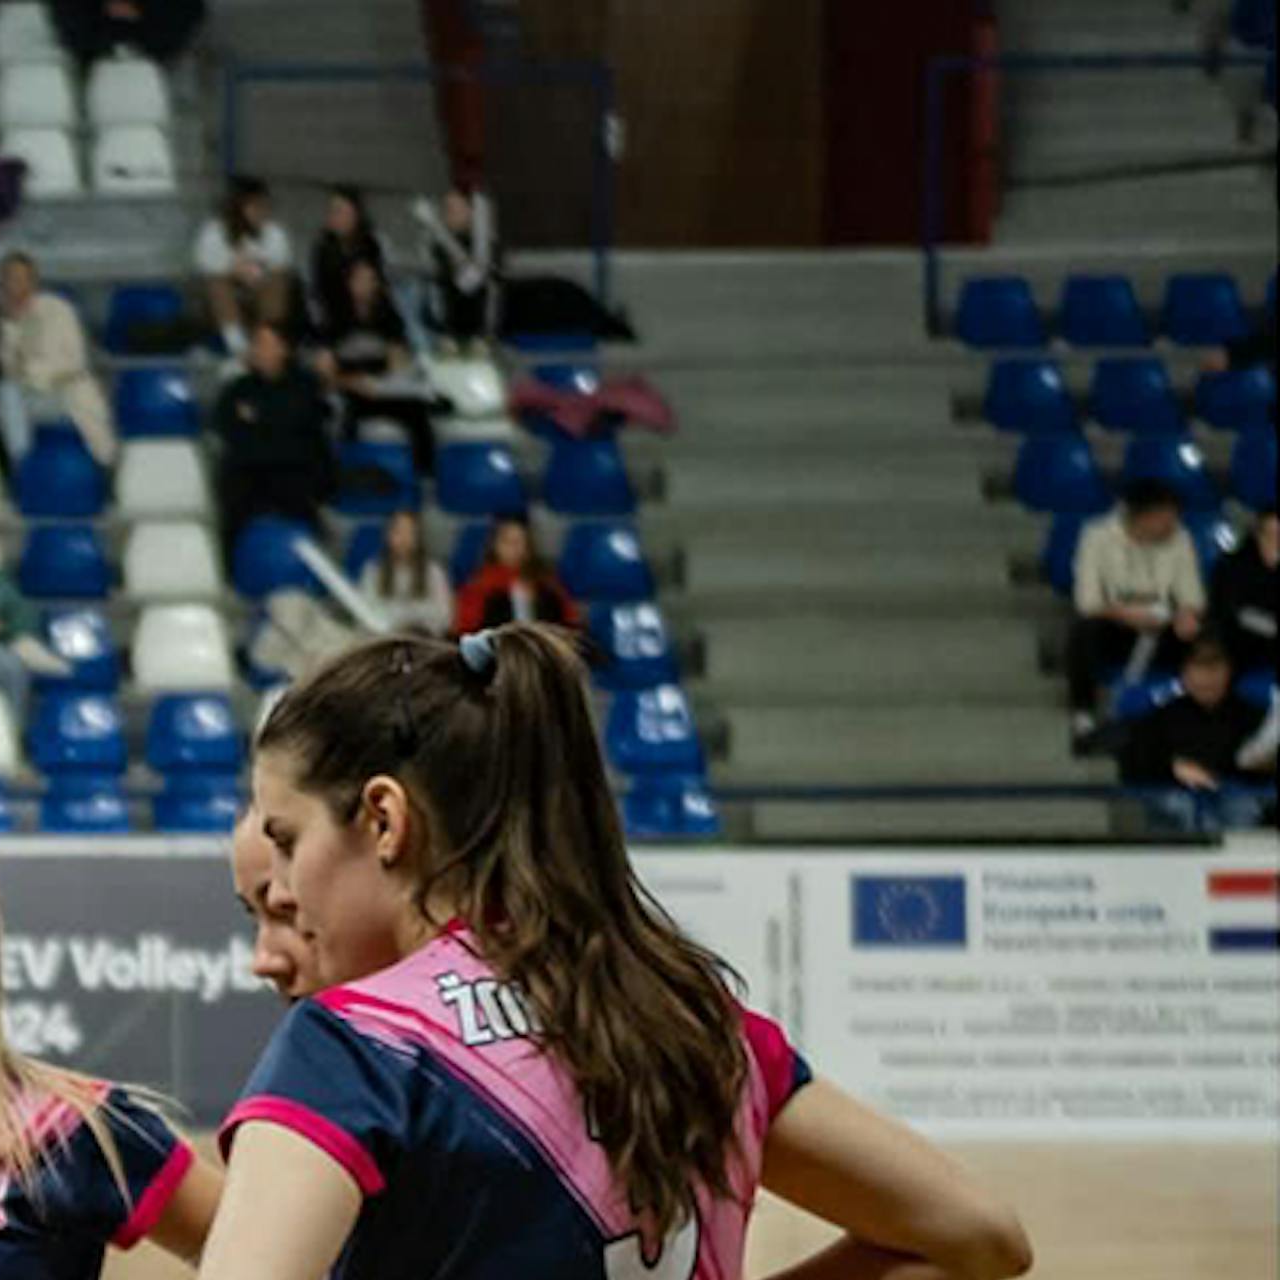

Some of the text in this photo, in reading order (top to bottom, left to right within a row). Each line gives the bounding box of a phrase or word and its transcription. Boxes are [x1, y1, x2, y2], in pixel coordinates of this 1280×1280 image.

[1, 932, 272, 1003] EV Volleyb
[1, 1002, 83, 1052] 24
